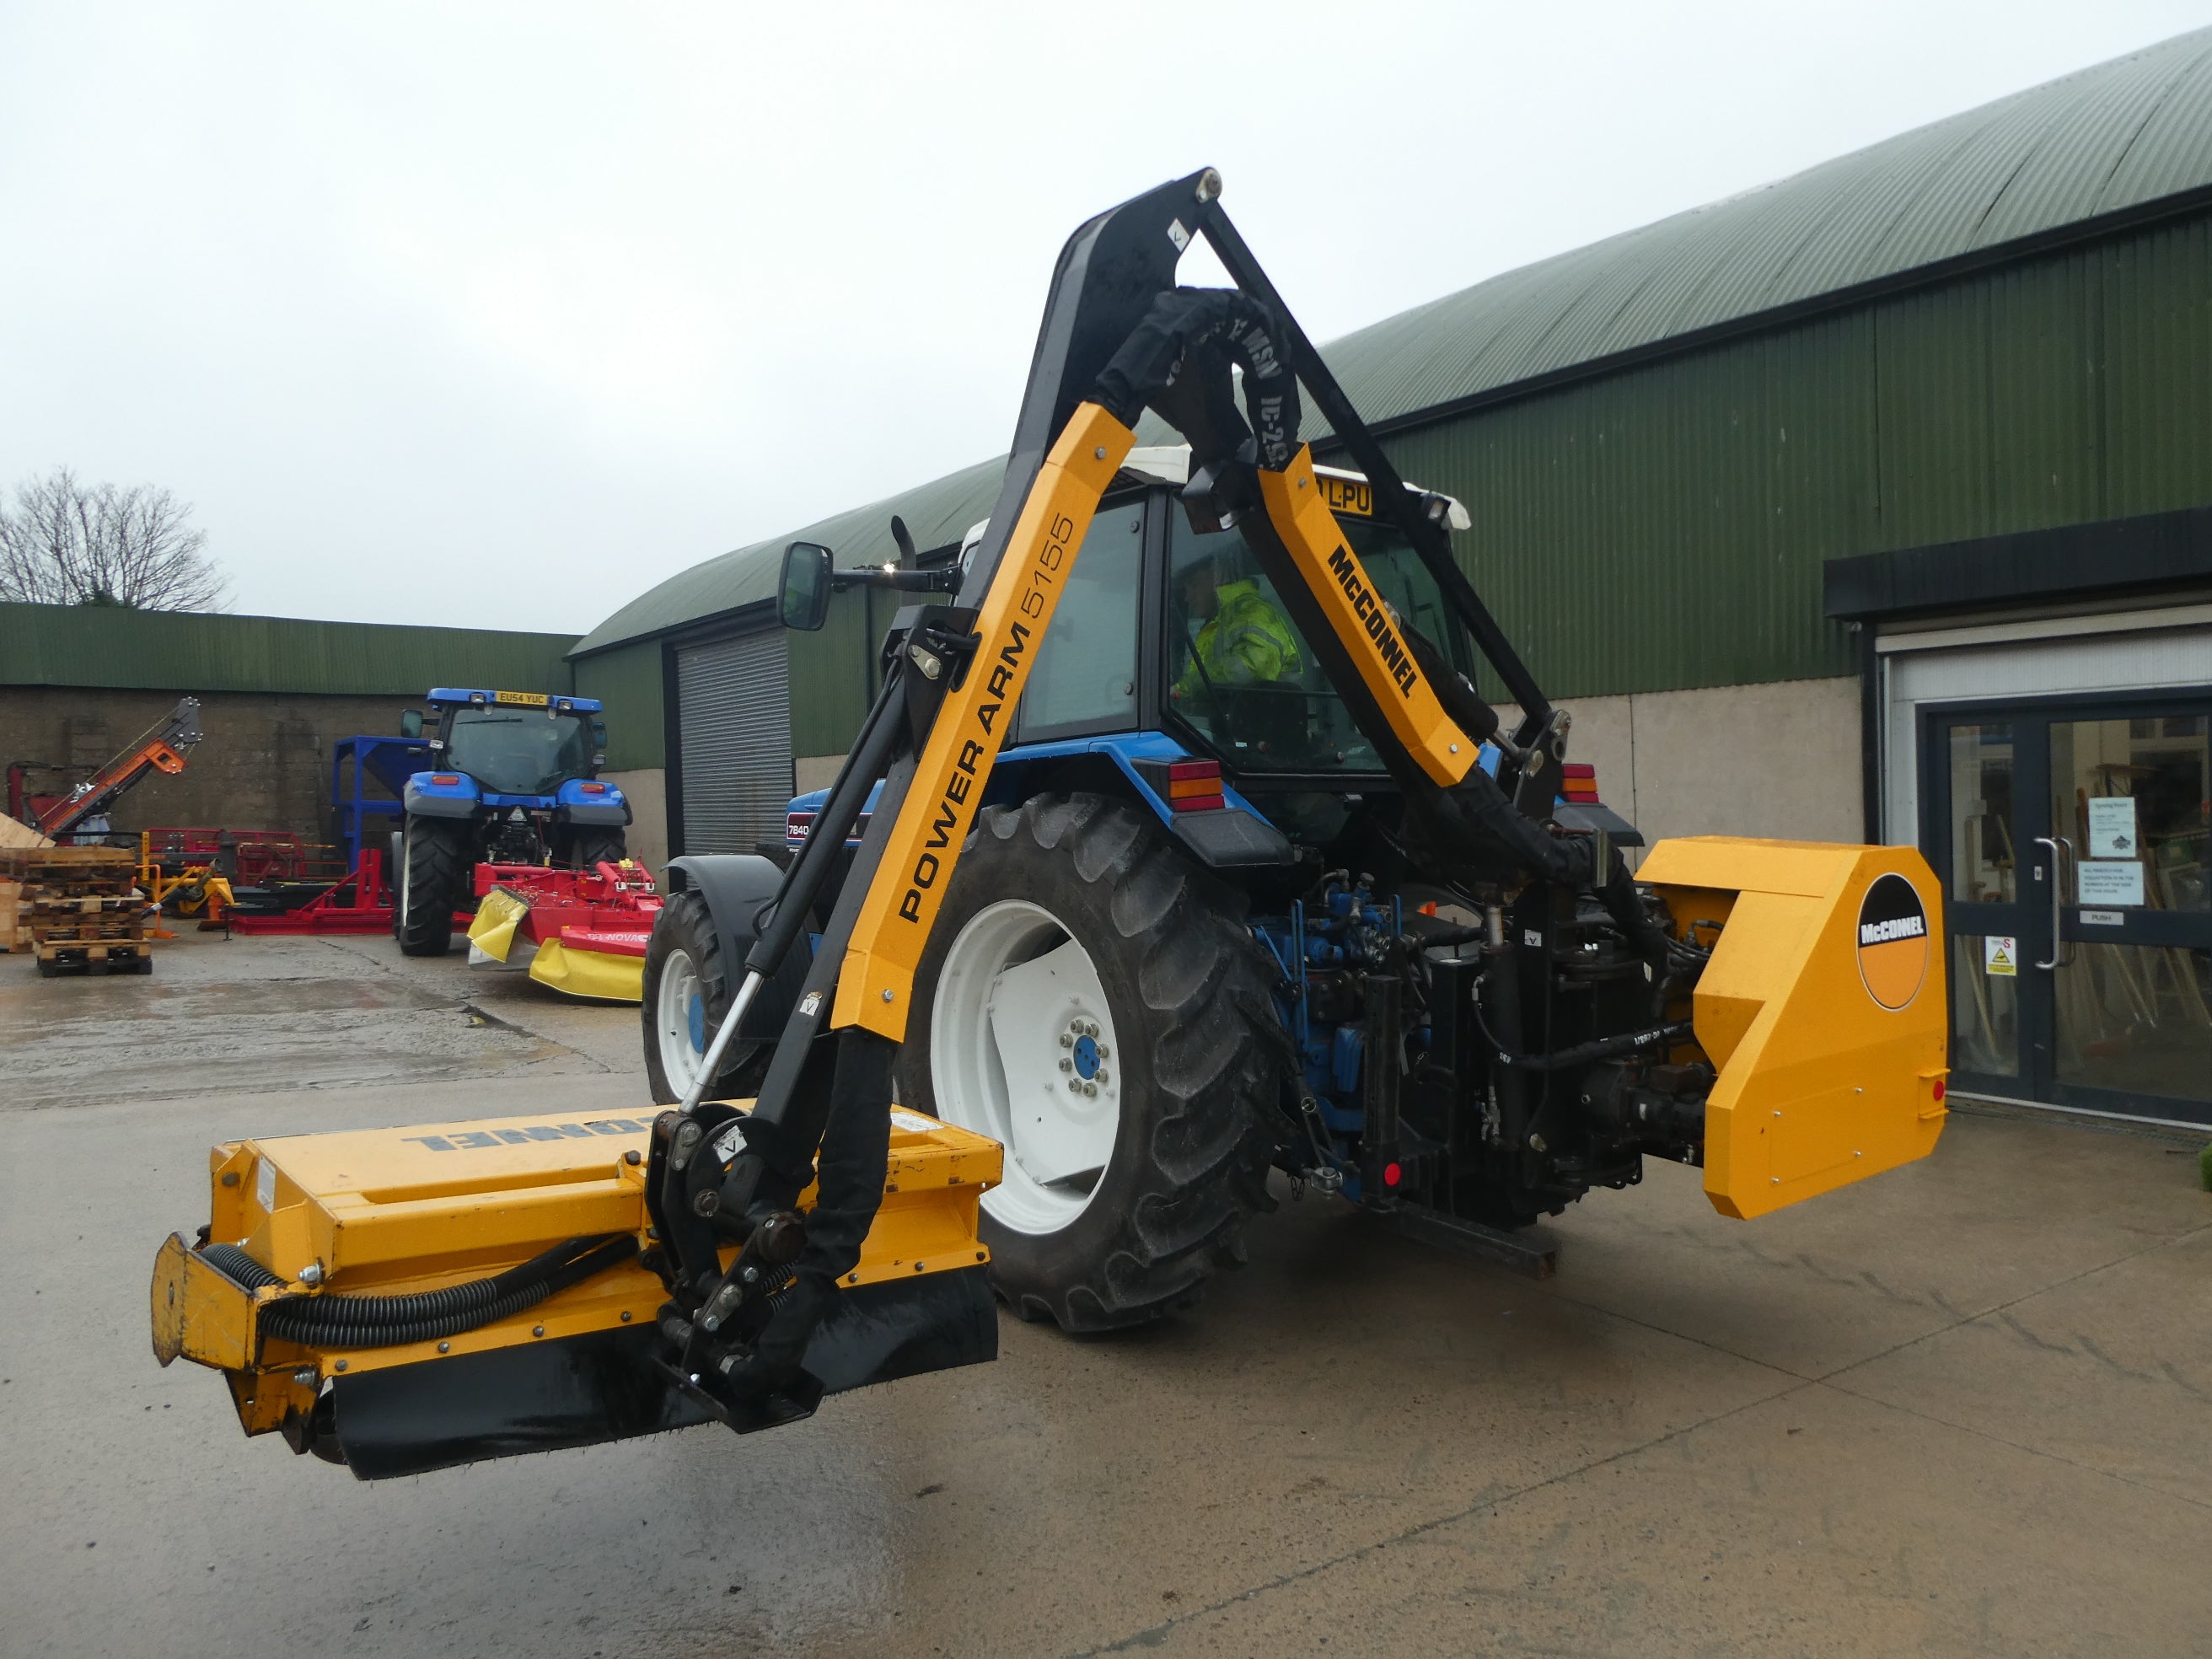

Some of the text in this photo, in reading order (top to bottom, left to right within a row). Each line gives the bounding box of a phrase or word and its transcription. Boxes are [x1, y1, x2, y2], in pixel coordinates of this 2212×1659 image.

[1329, 481, 1370, 512] LPU
[500, 692, 545, 704] EU54 YUC
[899, 513, 1073, 924] POWER ARM 5155
[788, 825, 809, 835] 7840
[606, 933, 649, 942] NOVAC
[401, 1116, 654, 1152] ONNEL
